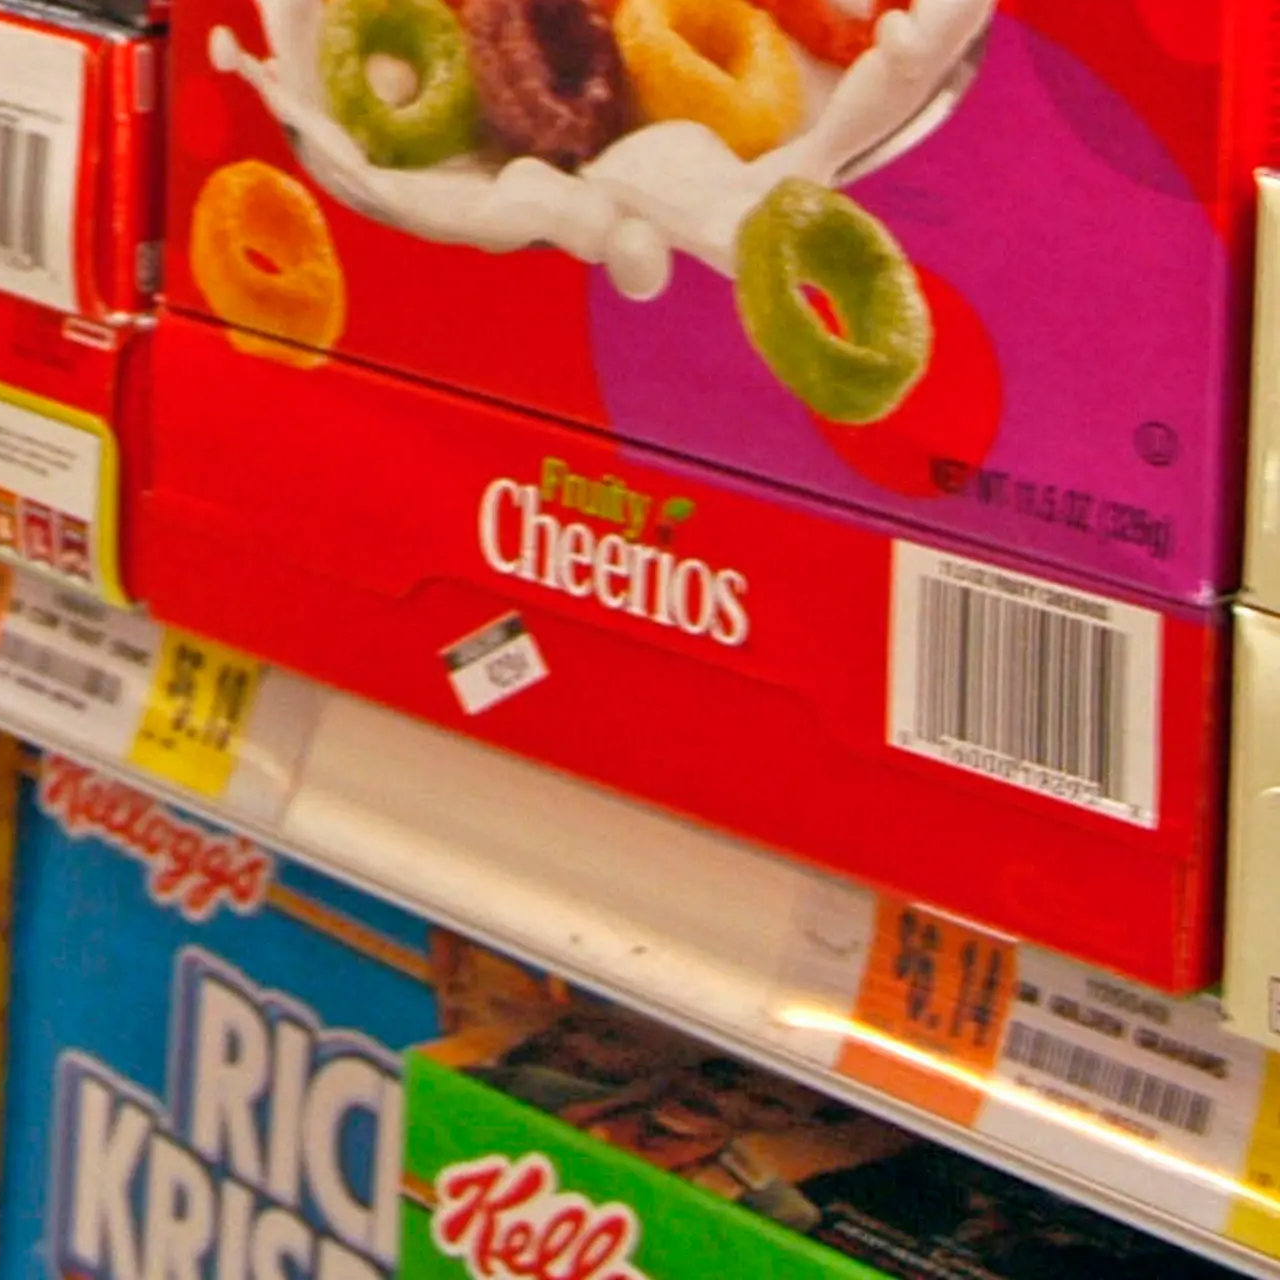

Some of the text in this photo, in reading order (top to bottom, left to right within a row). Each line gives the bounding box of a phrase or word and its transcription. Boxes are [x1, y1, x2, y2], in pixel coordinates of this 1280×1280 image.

[477, 476, 750, 647] Cheerios
[541, 454, 652, 540] Fruity
[42, 752, 270, 916] Kellogg's
[178, 955, 404, 1264] RIC
